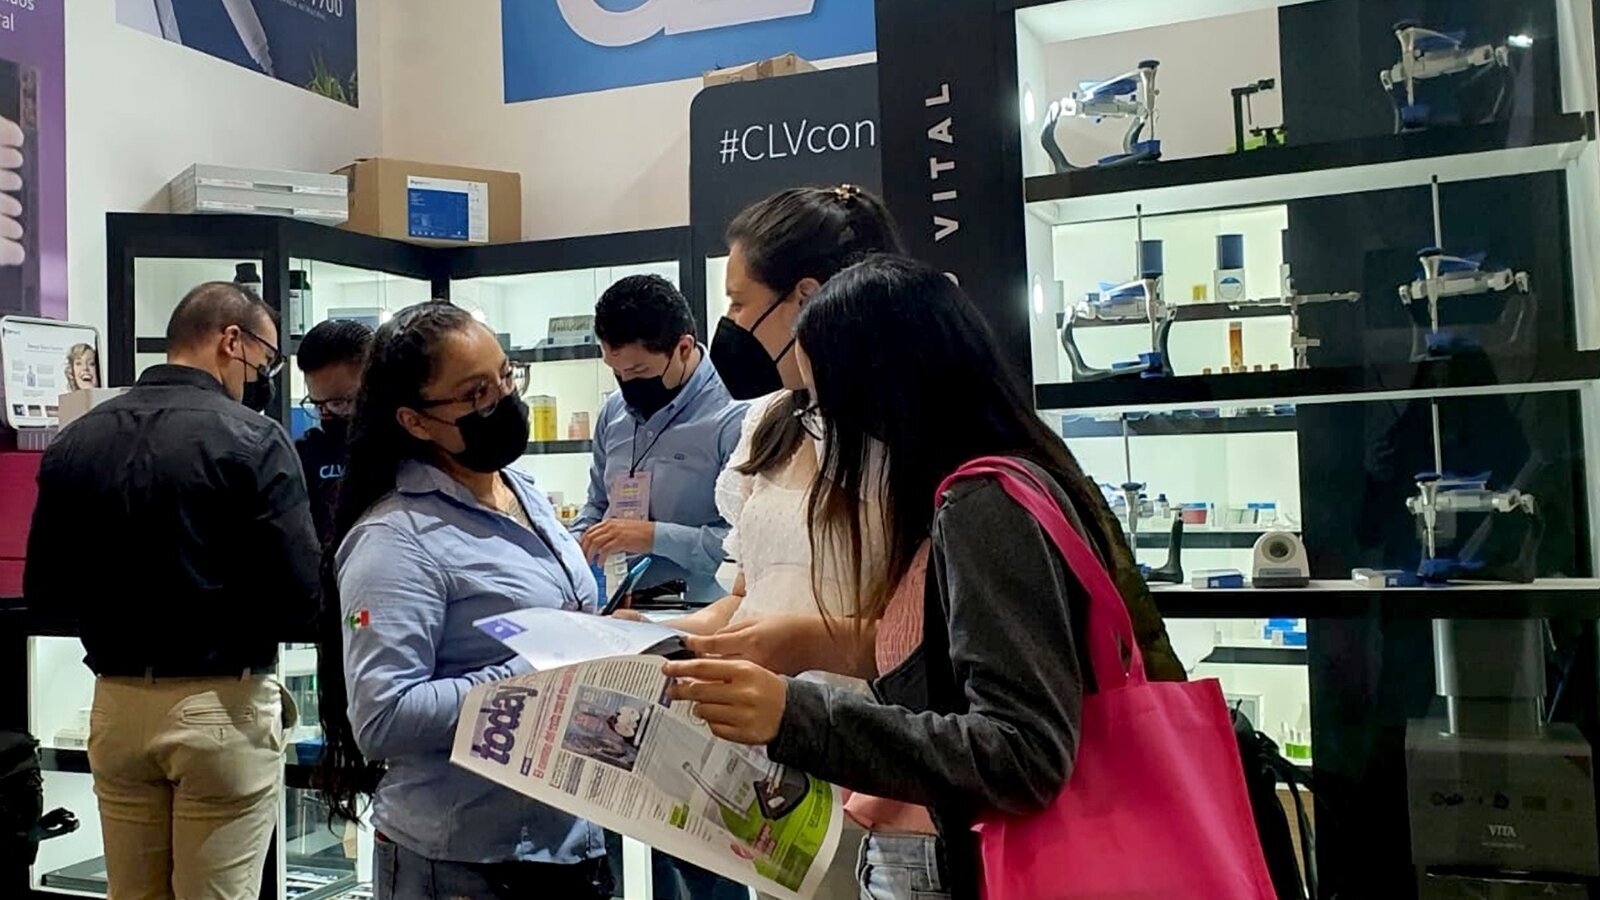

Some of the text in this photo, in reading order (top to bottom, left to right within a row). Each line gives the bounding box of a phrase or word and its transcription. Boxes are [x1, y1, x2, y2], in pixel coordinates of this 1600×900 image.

[719, 119, 875, 164] #CLVcon
[925, 83, 960, 243] VITAL
[471, 686, 539, 766] today
[1488, 824, 1517, 838] VITA
